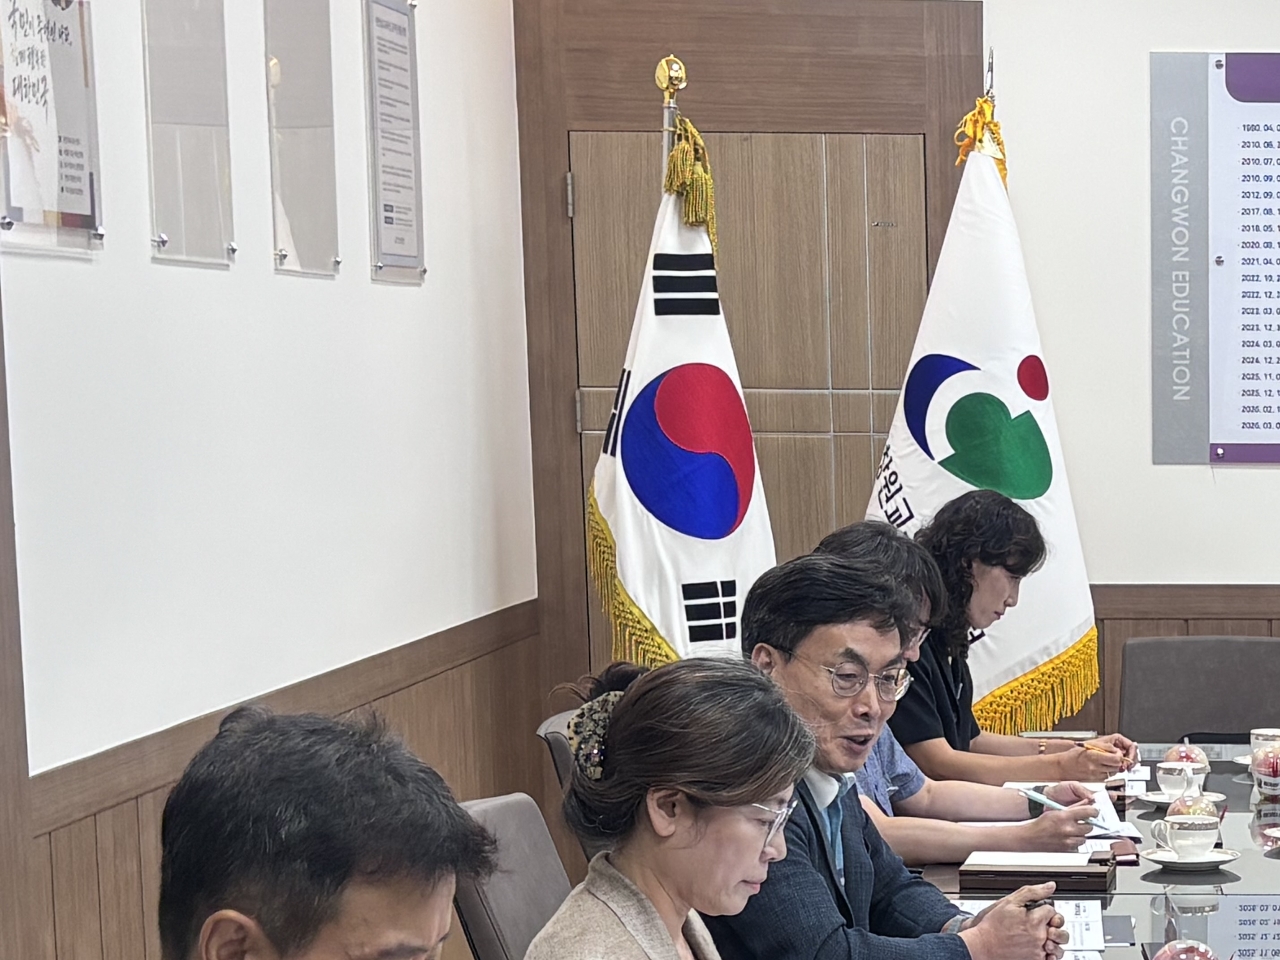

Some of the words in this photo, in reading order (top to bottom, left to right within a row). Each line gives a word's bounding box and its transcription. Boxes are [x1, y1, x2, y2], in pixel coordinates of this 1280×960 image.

[1263, 158, 1275, 167] 07.
[1263, 175, 1275, 184] 09.
[1170, 117, 1189, 262] CHANGWON
[1263, 192, 1275, 200] 09.
[1241, 208, 1262, 217] 2017.
[1172, 270, 1190, 401] EDUCATION
